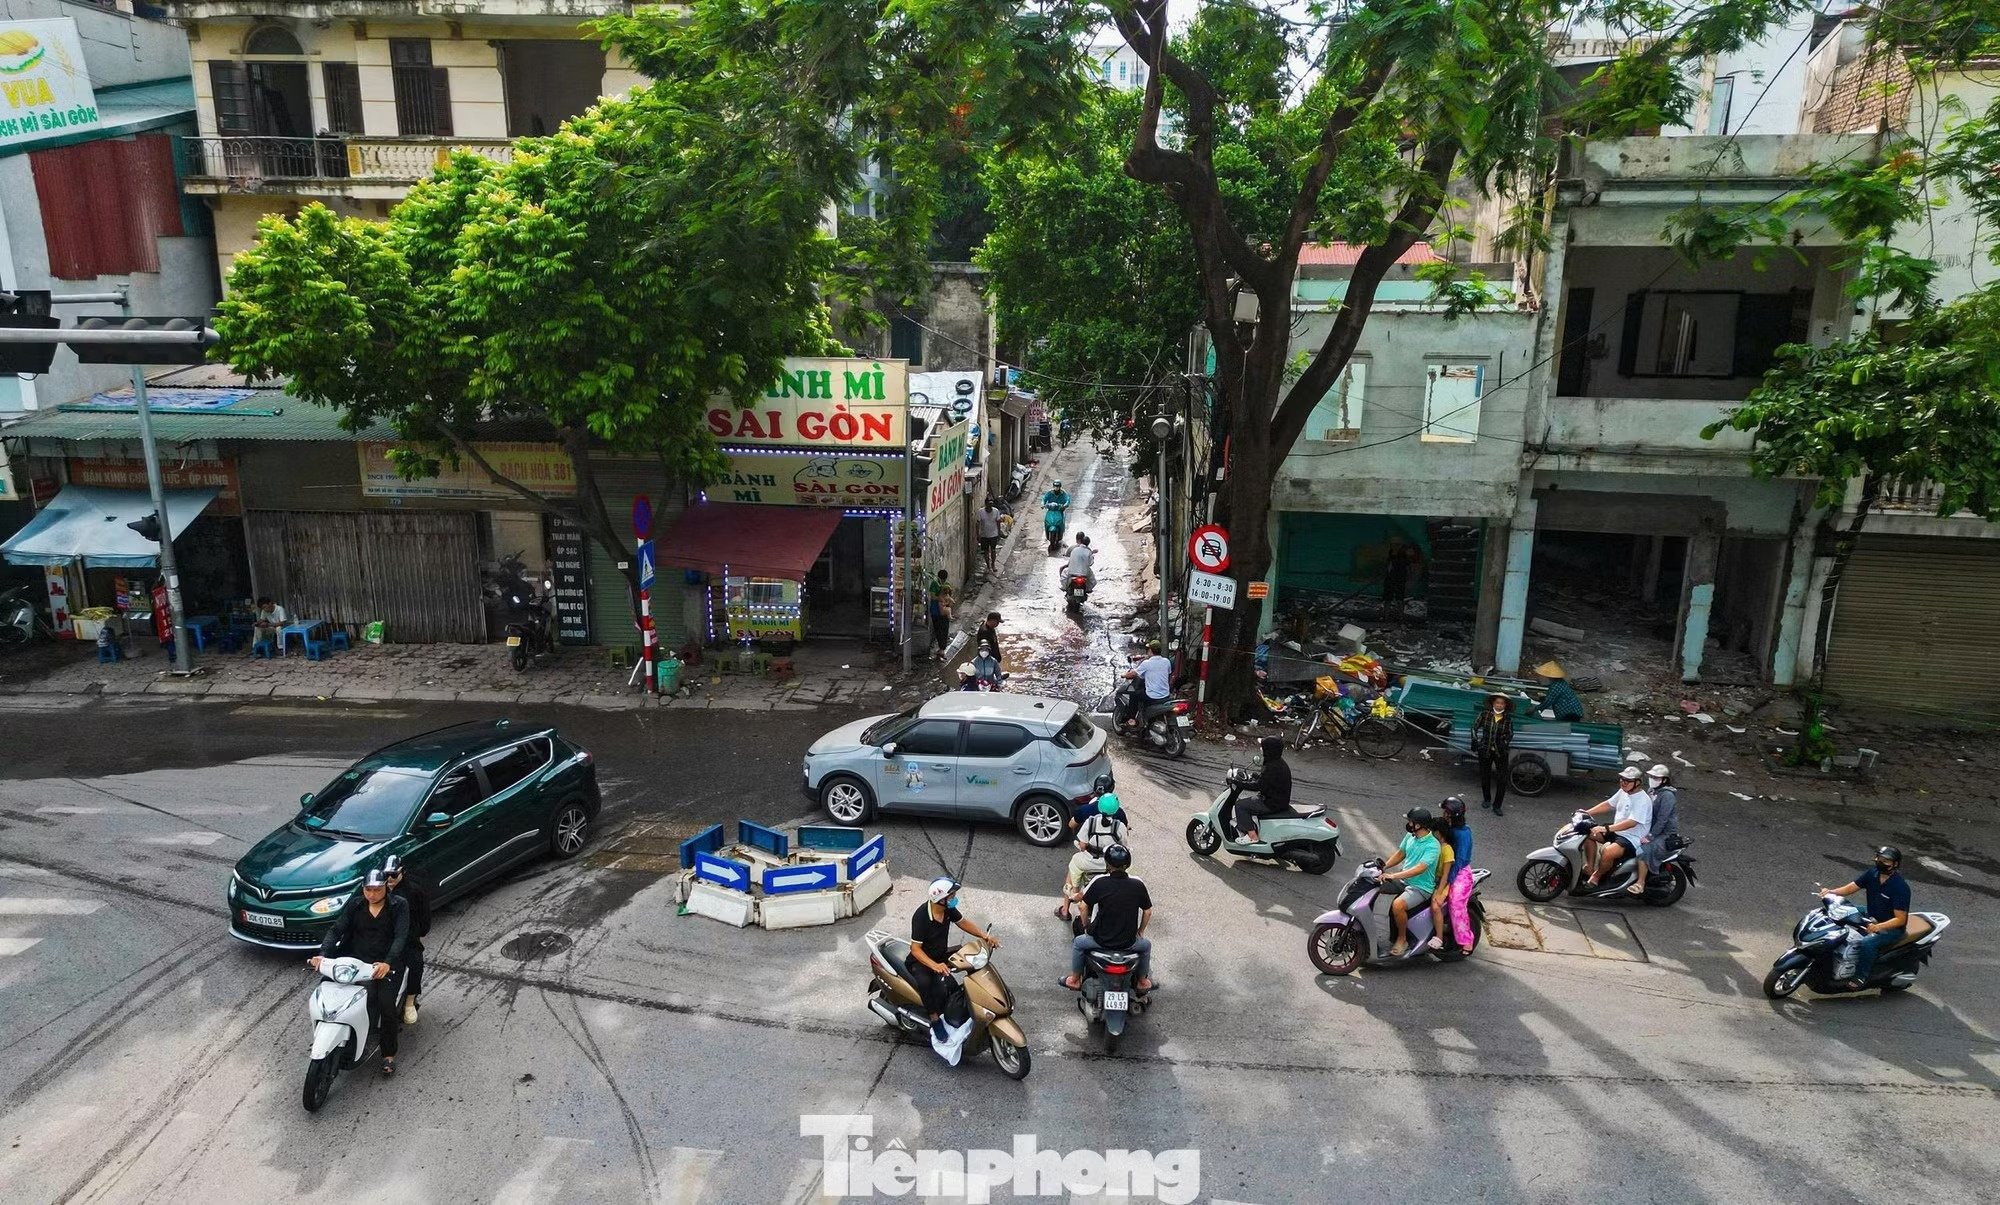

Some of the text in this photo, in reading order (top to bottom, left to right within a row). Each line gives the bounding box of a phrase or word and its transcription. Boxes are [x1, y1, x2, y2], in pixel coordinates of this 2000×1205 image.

[2, 78, 55, 109] VUA
[20, 110, 40, 134] MÌ
[40, 108, 67, 131] SÀI
[68, 105, 98, 127] GÒN
[843, 363, 886, 400] MÌ
[797, 404, 893, 442] GÒN
[721, 470, 777, 487] BÁNH
[794, 480, 899, 496] SÀI GÒN
[733, 487, 762, 502] MÌ
